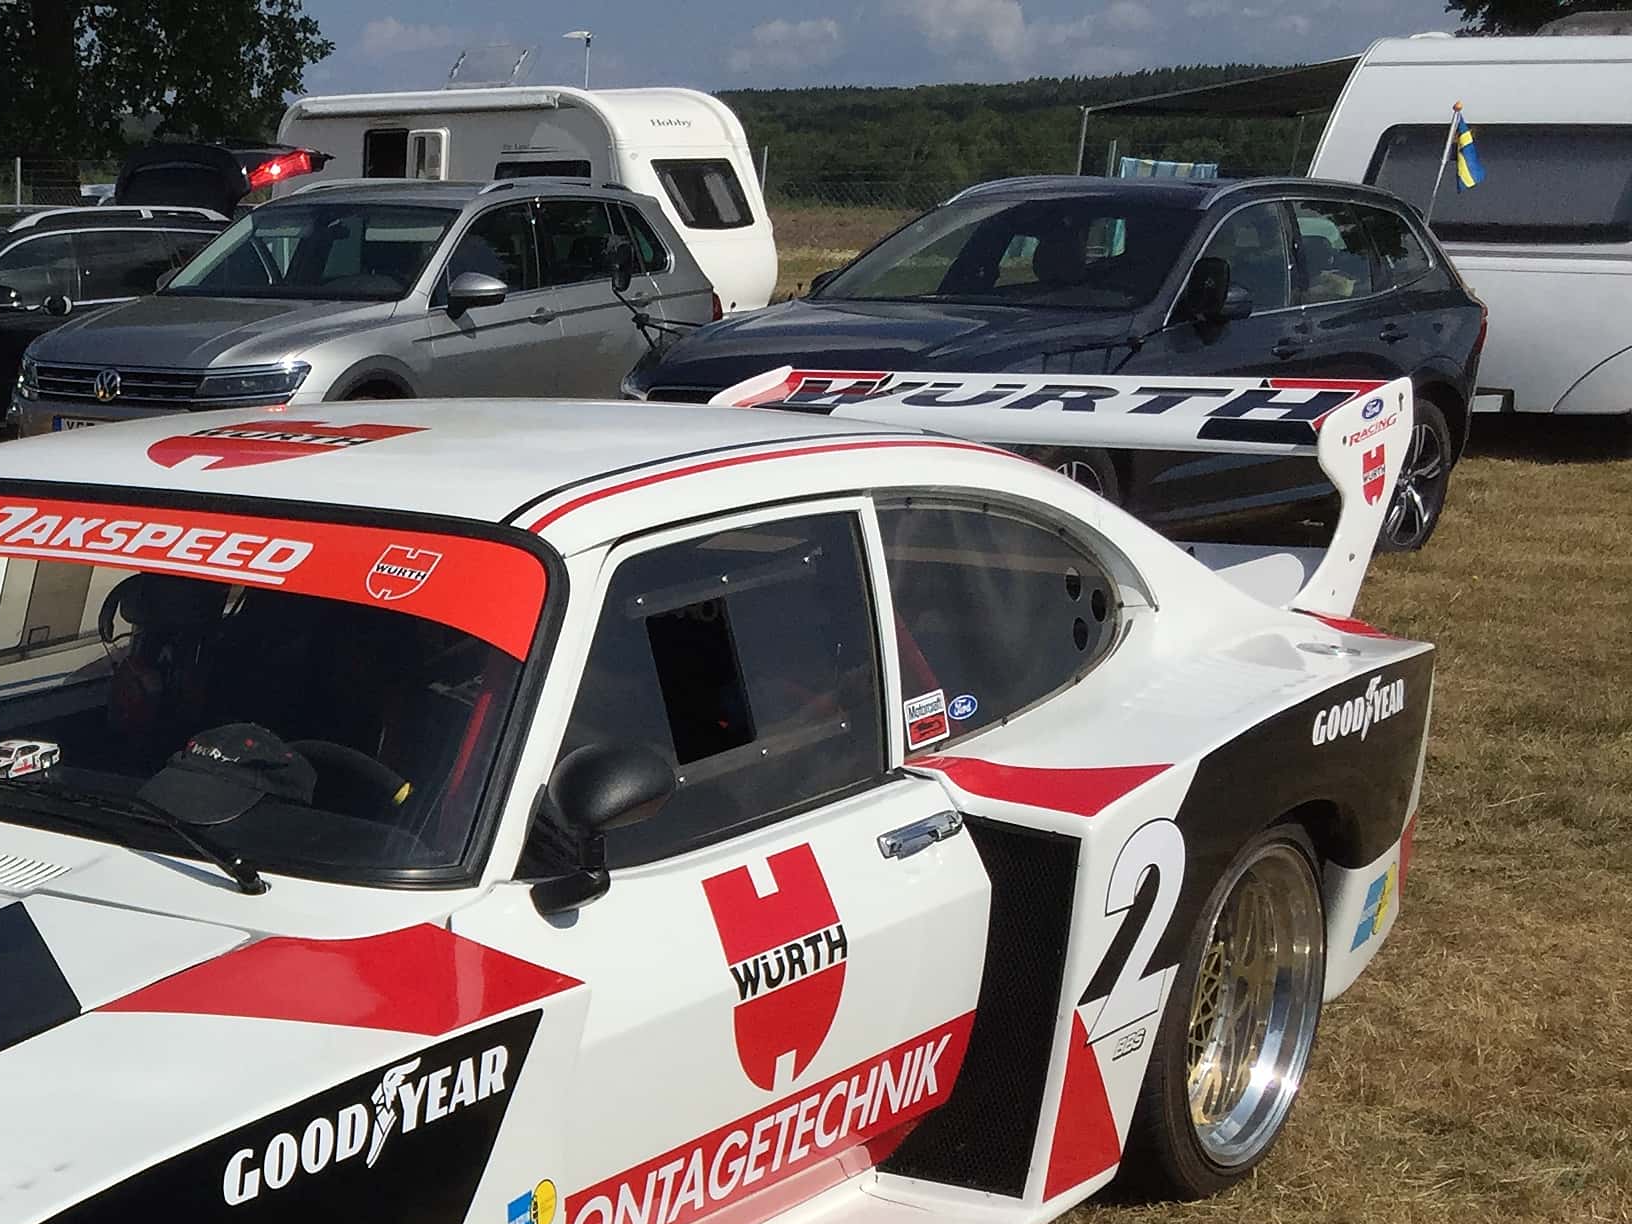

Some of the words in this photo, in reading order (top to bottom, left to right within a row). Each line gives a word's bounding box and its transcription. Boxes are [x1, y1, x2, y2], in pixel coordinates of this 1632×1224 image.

[650, 119, 692, 128] Hobby
[1349, 412, 1397, 447] RACING
[1081, 817, 1186, 1045] 2
[729, 924, 848, 1001] WÜRTH
